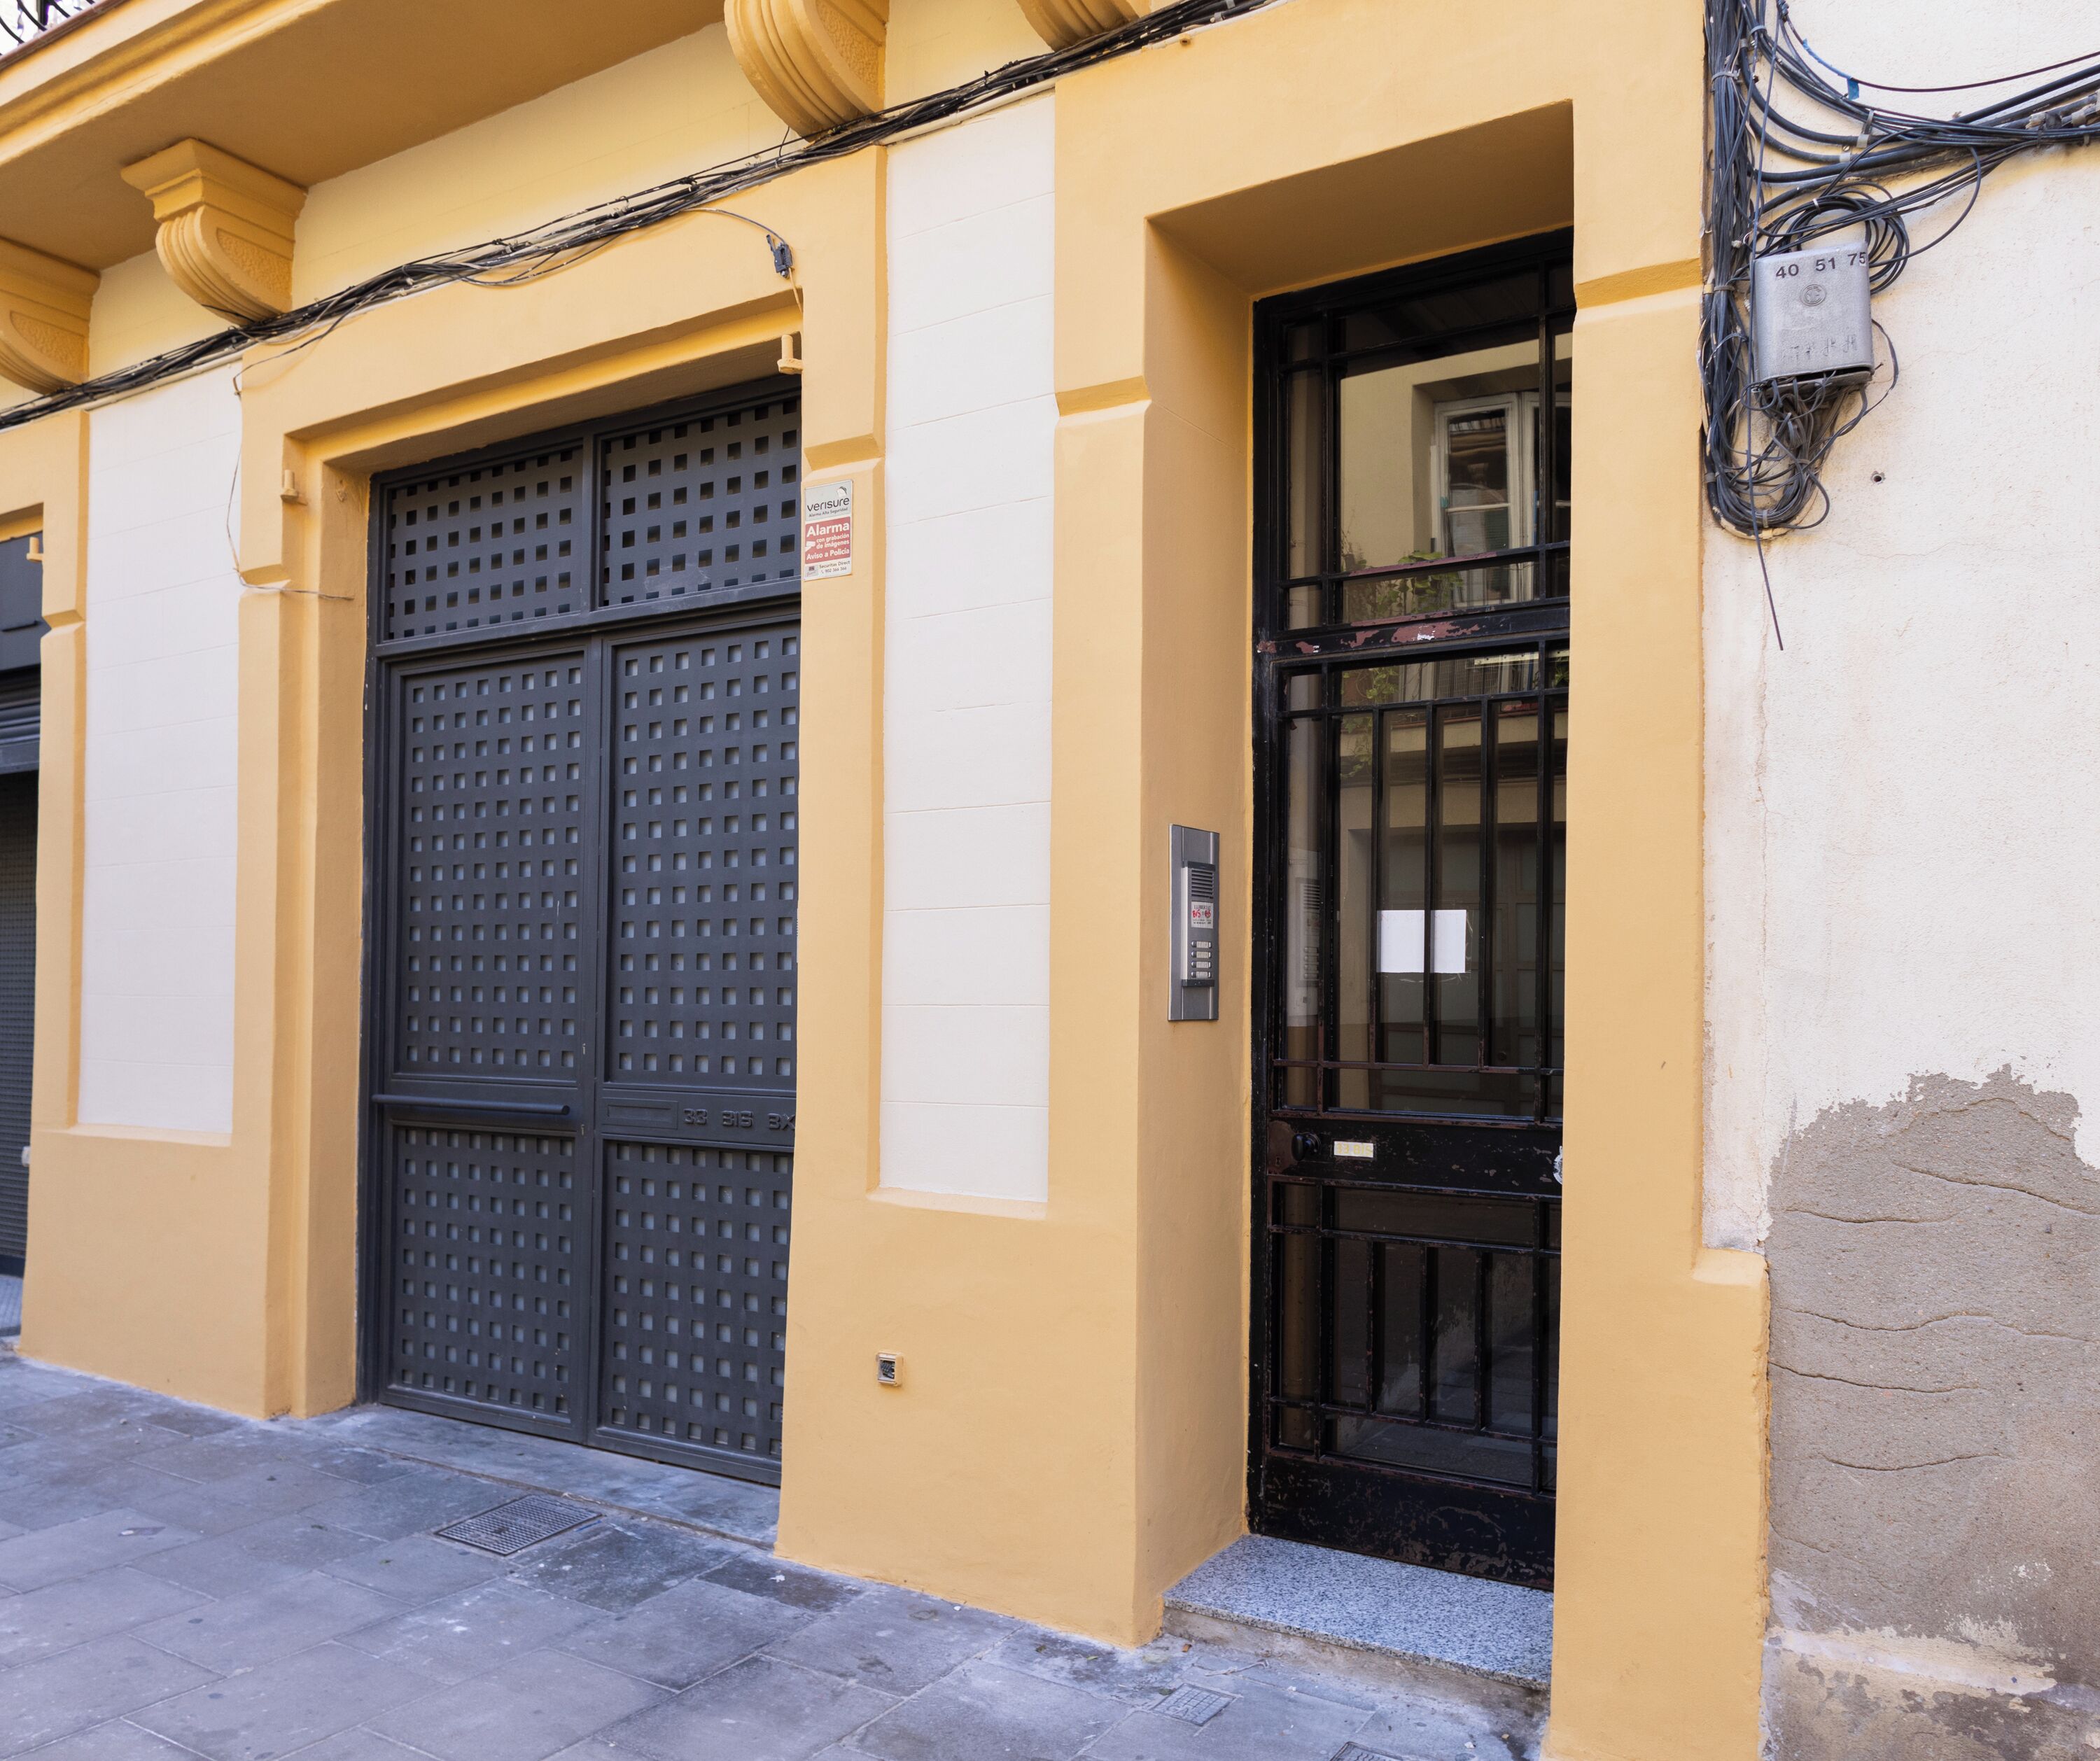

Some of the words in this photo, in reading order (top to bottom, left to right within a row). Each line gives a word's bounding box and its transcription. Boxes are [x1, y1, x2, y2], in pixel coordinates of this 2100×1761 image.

[1776, 264, 1799, 279] 40
[1816, 257, 1836, 272] 51
[1847, 252, 1866, 266] 75
[807, 498, 850, 512] verisure
[806, 522, 850, 538] Alarma
[826, 533, 850, 542] grabación
[824, 540, 850, 548] imágenes
[830, 547, 850, 556] Policía
